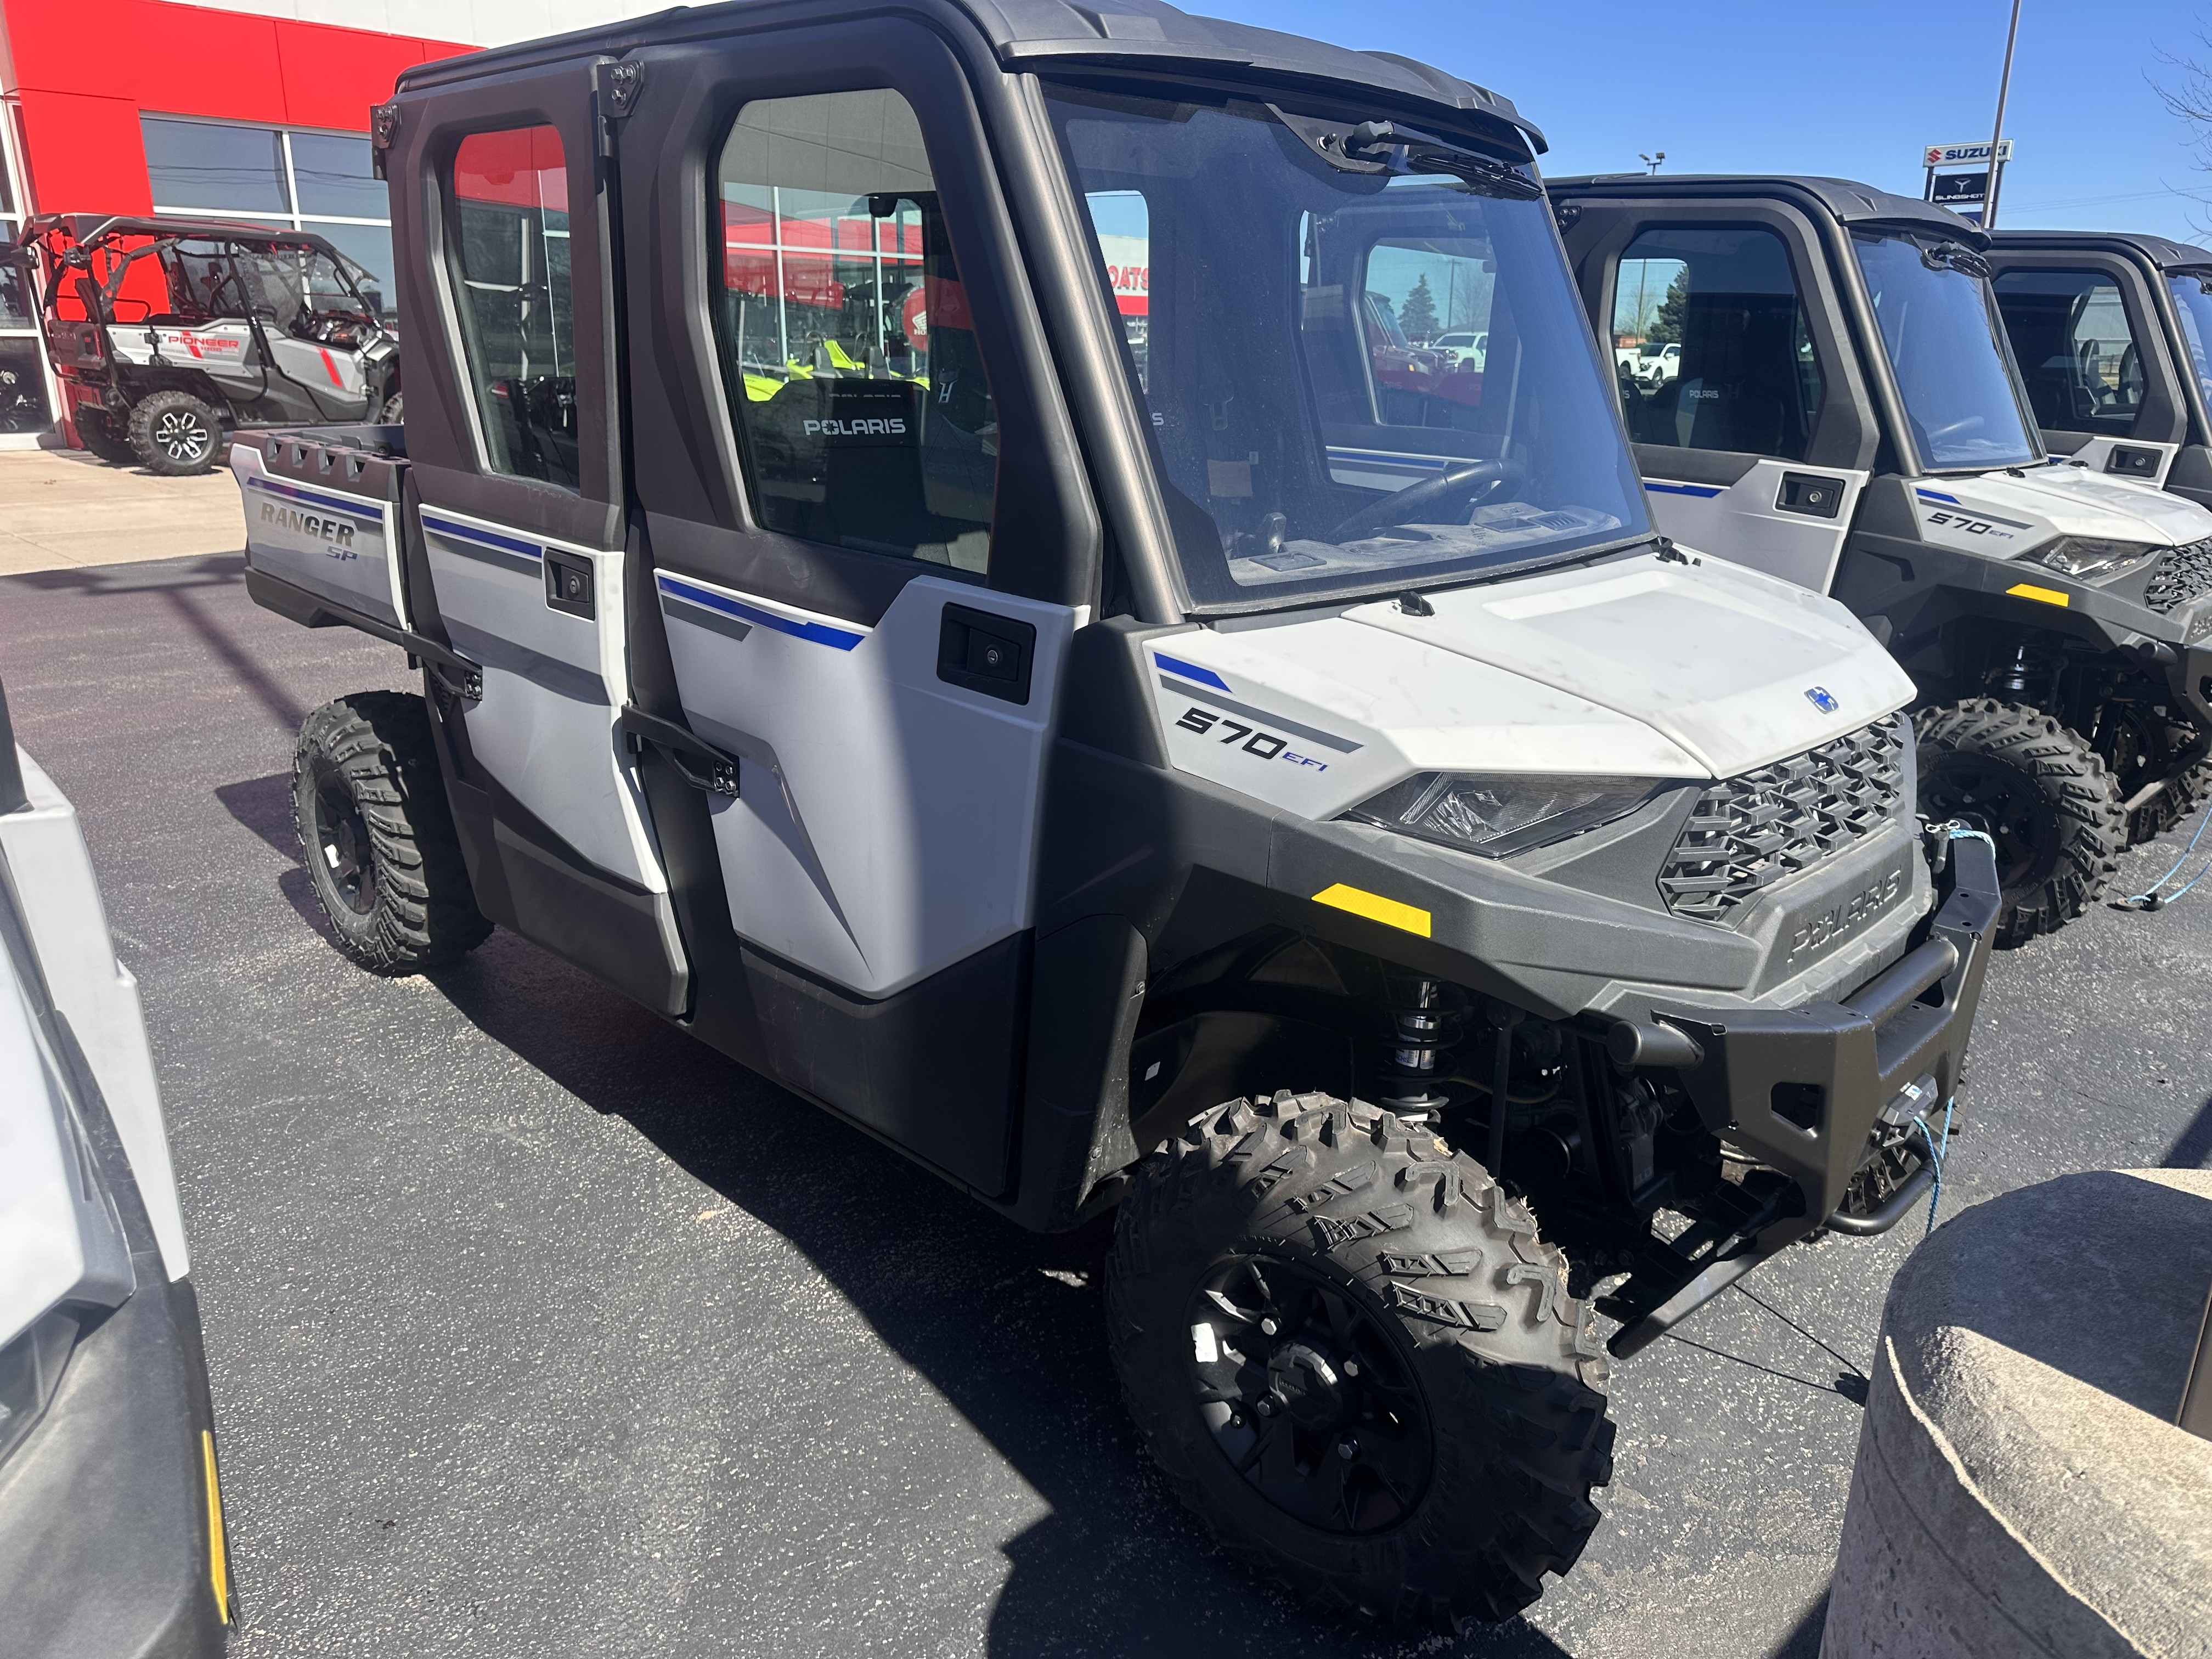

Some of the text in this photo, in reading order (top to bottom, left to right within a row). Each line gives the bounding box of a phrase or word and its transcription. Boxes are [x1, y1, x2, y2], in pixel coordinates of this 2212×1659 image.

[168, 336, 239, 348] PIONEER
[1689, 390, 1719, 399] POLARIS
[803, 418, 906, 436] POLARIS
[261, 502, 355, 548] RANGER
[1927, 512, 2014, 539] 570 EFI
[326, 546, 358, 561] SP
[1175, 707, 1329, 772] 570 EFI
[1787, 865, 1902, 963] POLARIS
